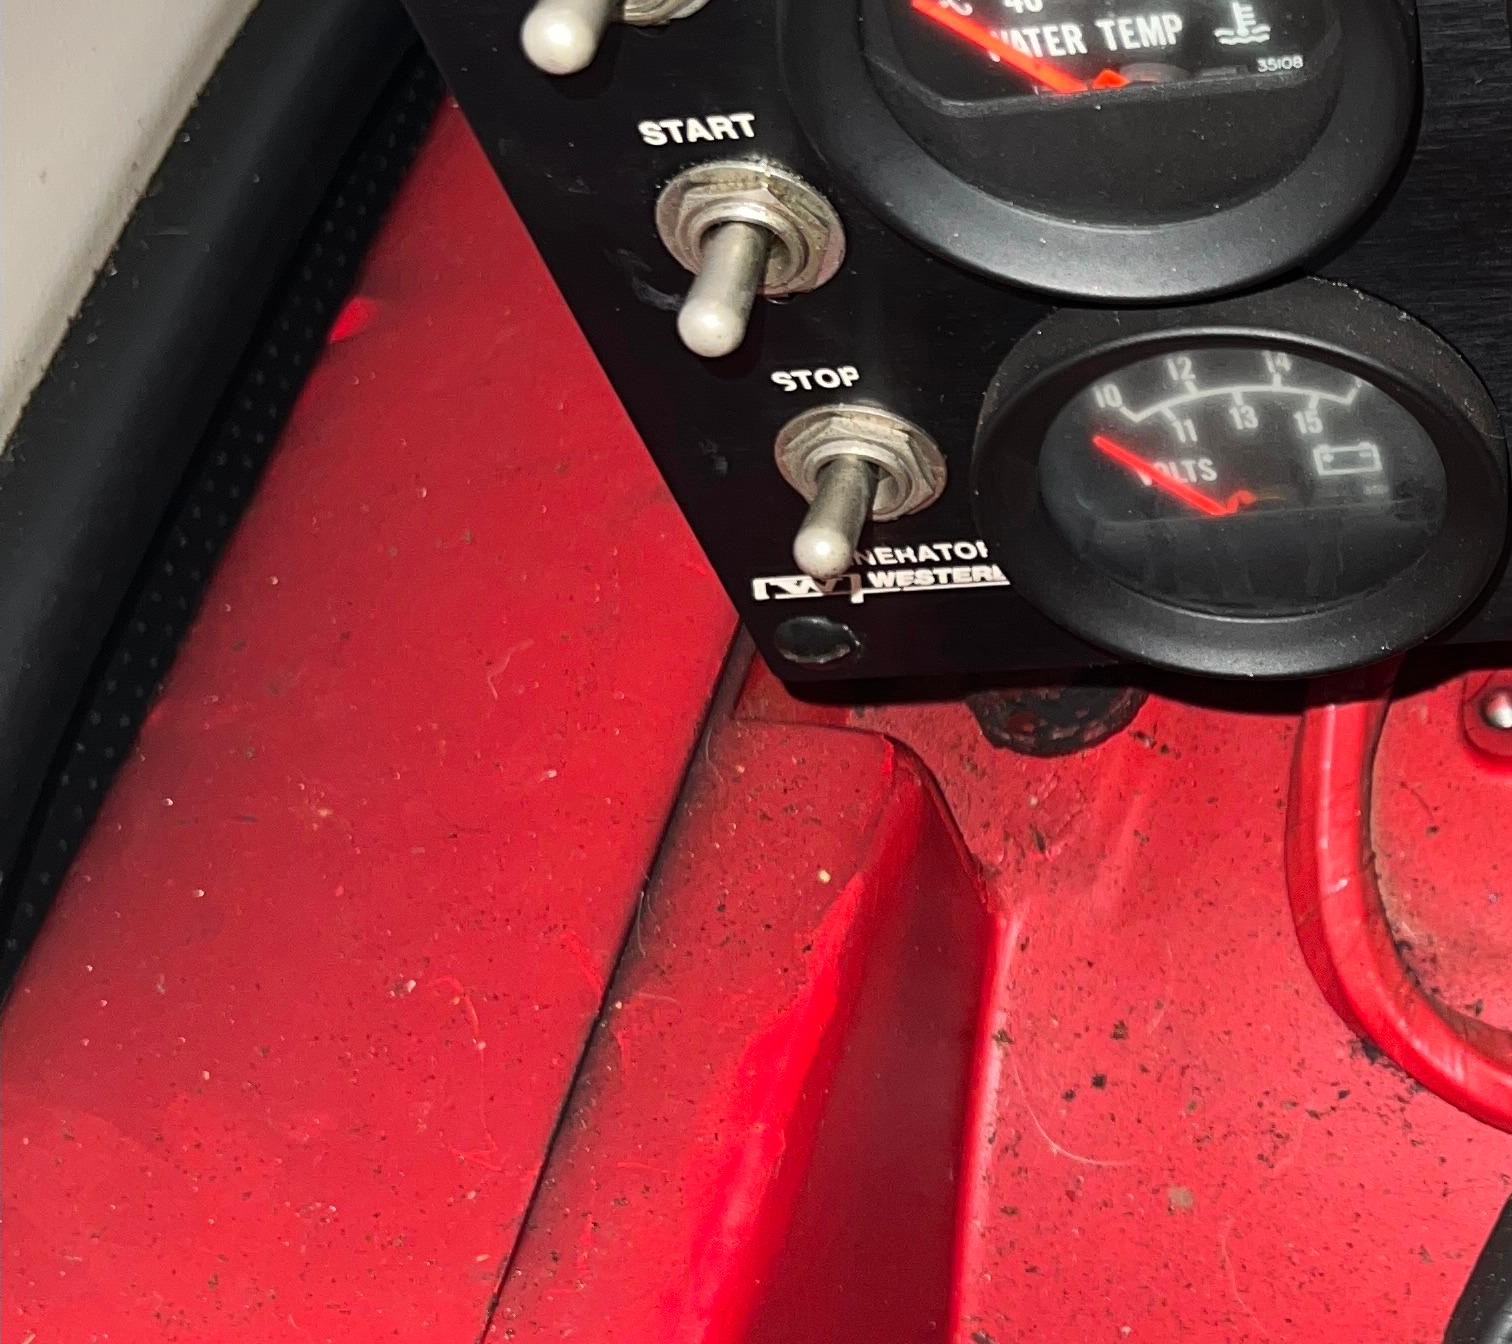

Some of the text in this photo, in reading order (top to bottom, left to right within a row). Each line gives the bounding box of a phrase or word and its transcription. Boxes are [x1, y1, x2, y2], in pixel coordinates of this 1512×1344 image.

[1094, 14, 1183, 51] TEMP
[637, 113, 755, 146] START
[771, 365, 860, 392] STOP
[1093, 384, 1123, 409] 10
[1165, 356, 1196, 381] 12
[1173, 406, 1322, 443] 11 13 15
